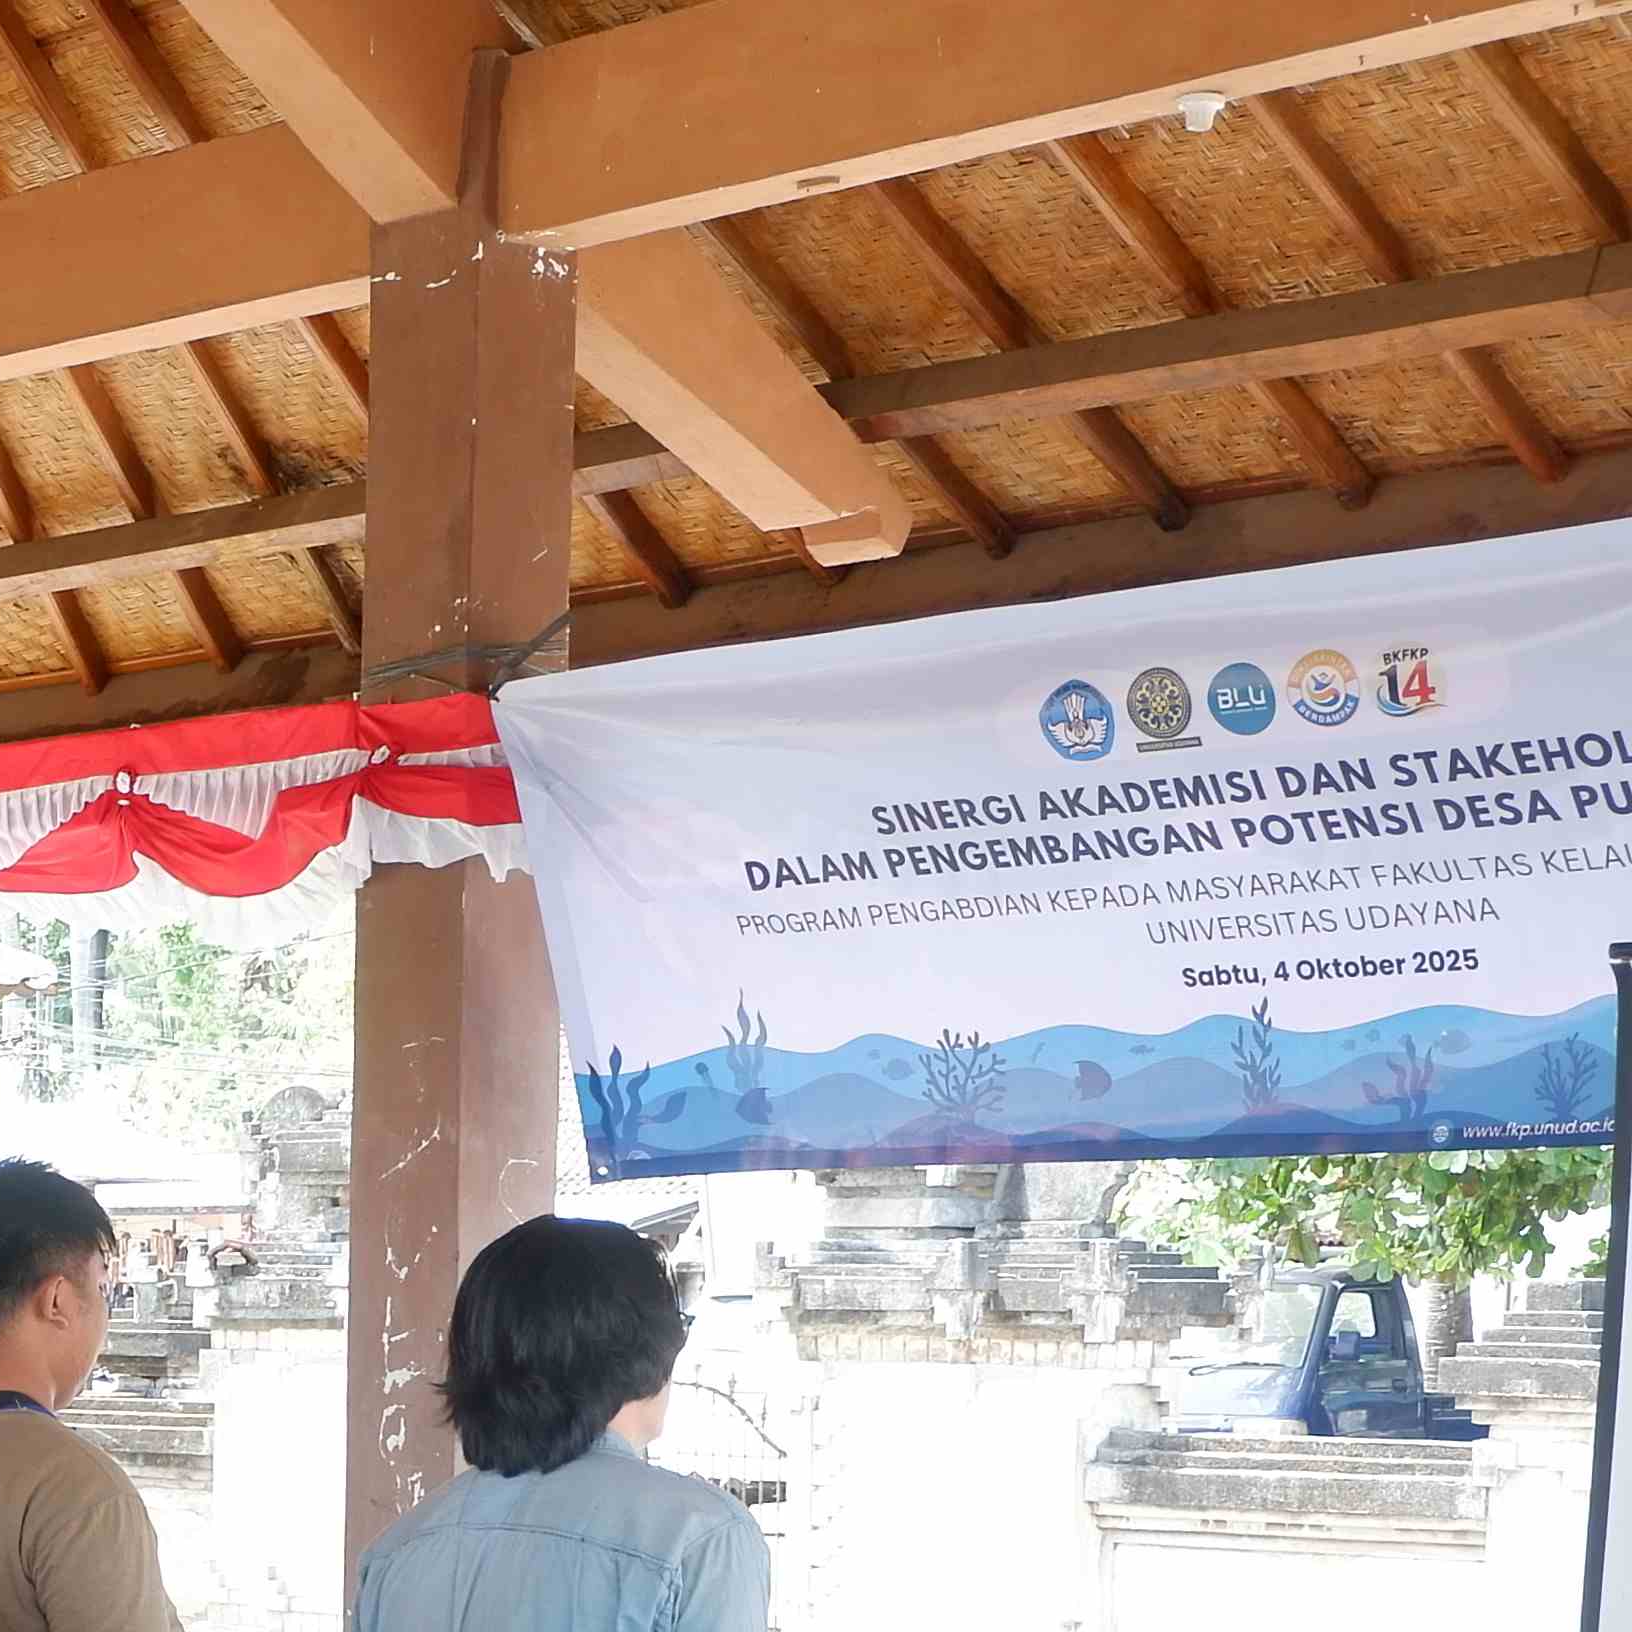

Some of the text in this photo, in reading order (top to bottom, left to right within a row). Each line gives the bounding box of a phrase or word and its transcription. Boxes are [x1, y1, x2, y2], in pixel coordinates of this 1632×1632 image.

[1382, 648, 1429, 665] BKFKP
[1378, 660, 1437, 706] 14
[871, 730, 1632, 836] SINERGI AKADEMISI DAN STAKEHOL
[744, 780, 1632, 892] DALAM PENGEMBANGAN POTENSI DESA PU
[736, 905, 863, 937] PROGRAM
[869, 892, 1042, 927] PENGABDIAN
[1046, 879, 1161, 912] KEPADA
[1166, 866, 1362, 903] MASYARAKAT
[1370, 852, 1535, 887] FAKULTAS
[1145, 896, 1501, 946] UNIVERSITAS UDAYANA
[1182, 948, 1480, 988] Sabtu, 4 Oktober 2025
